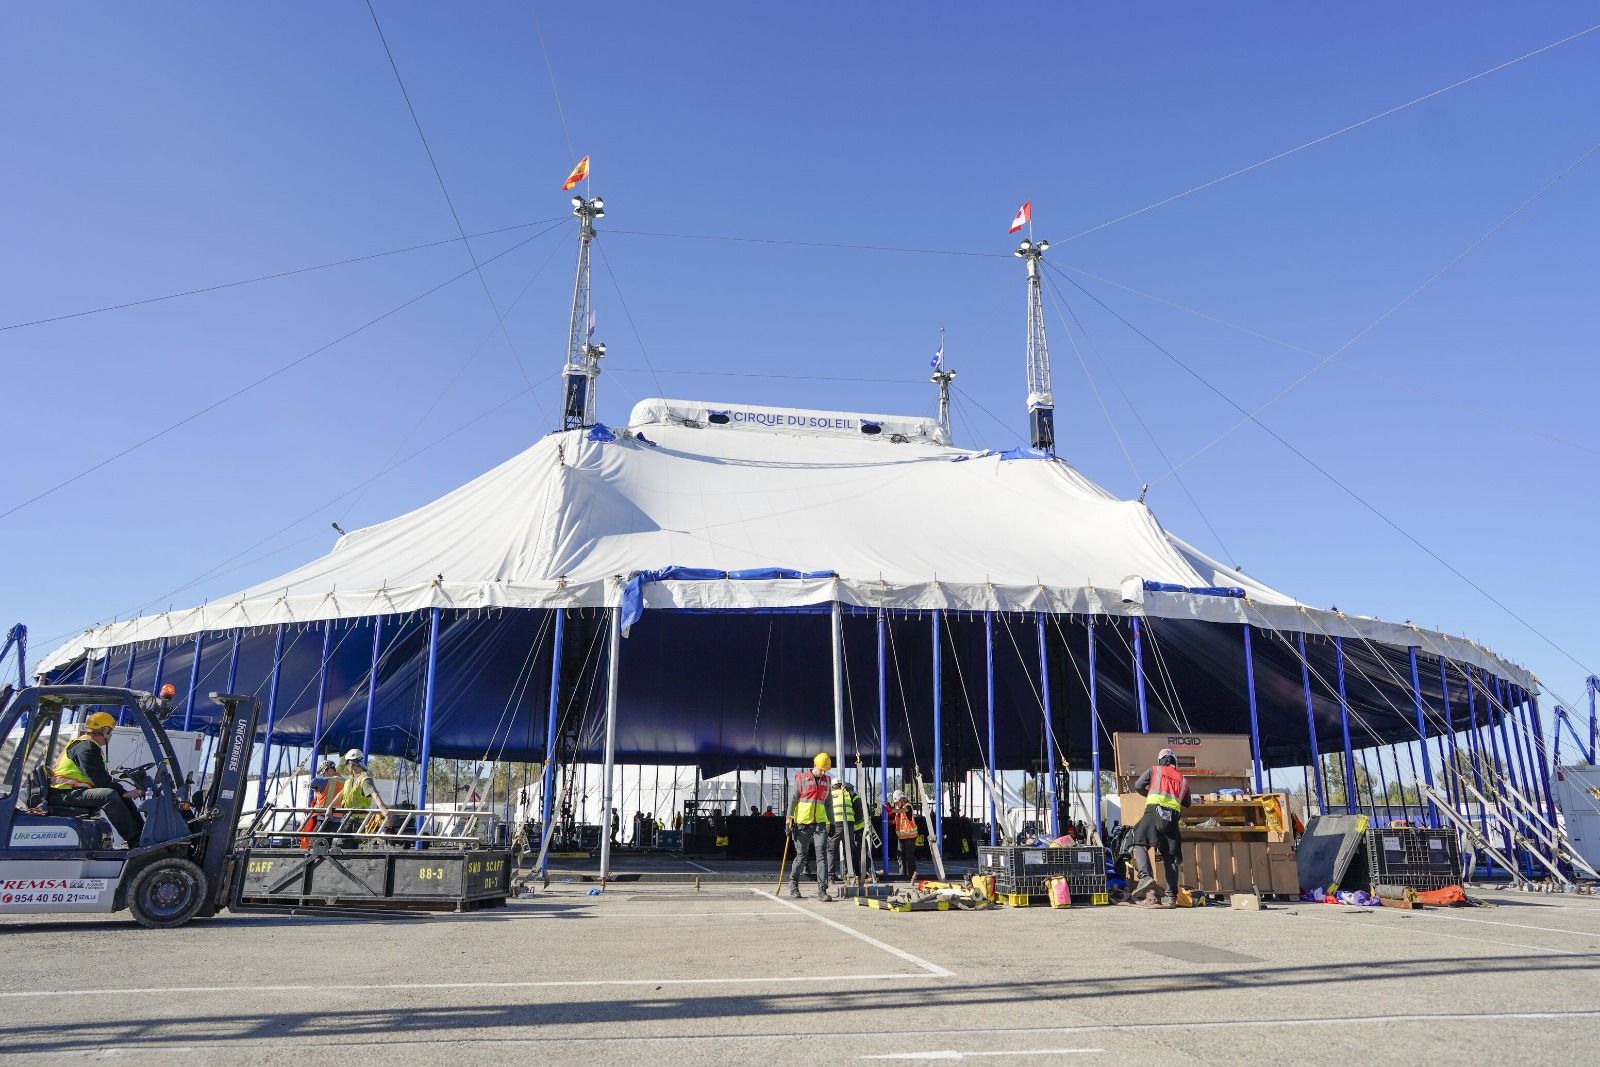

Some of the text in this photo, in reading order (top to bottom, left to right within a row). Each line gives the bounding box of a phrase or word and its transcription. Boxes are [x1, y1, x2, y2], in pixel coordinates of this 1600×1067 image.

[734, 411, 854, 429] CIRQUE DU SOLEIL
[1167, 737, 1201, 745] RIDGID
[247, 861, 274, 873] CAFF
[419, 867, 443, 880] 88-3
[0, 878, 67, 890] REMSA
[14, 893, 33, 903] 954
[36, 893, 49, 903] 40
[51, 893, 64, 903] 50
[66, 893, 78, 903] 21
